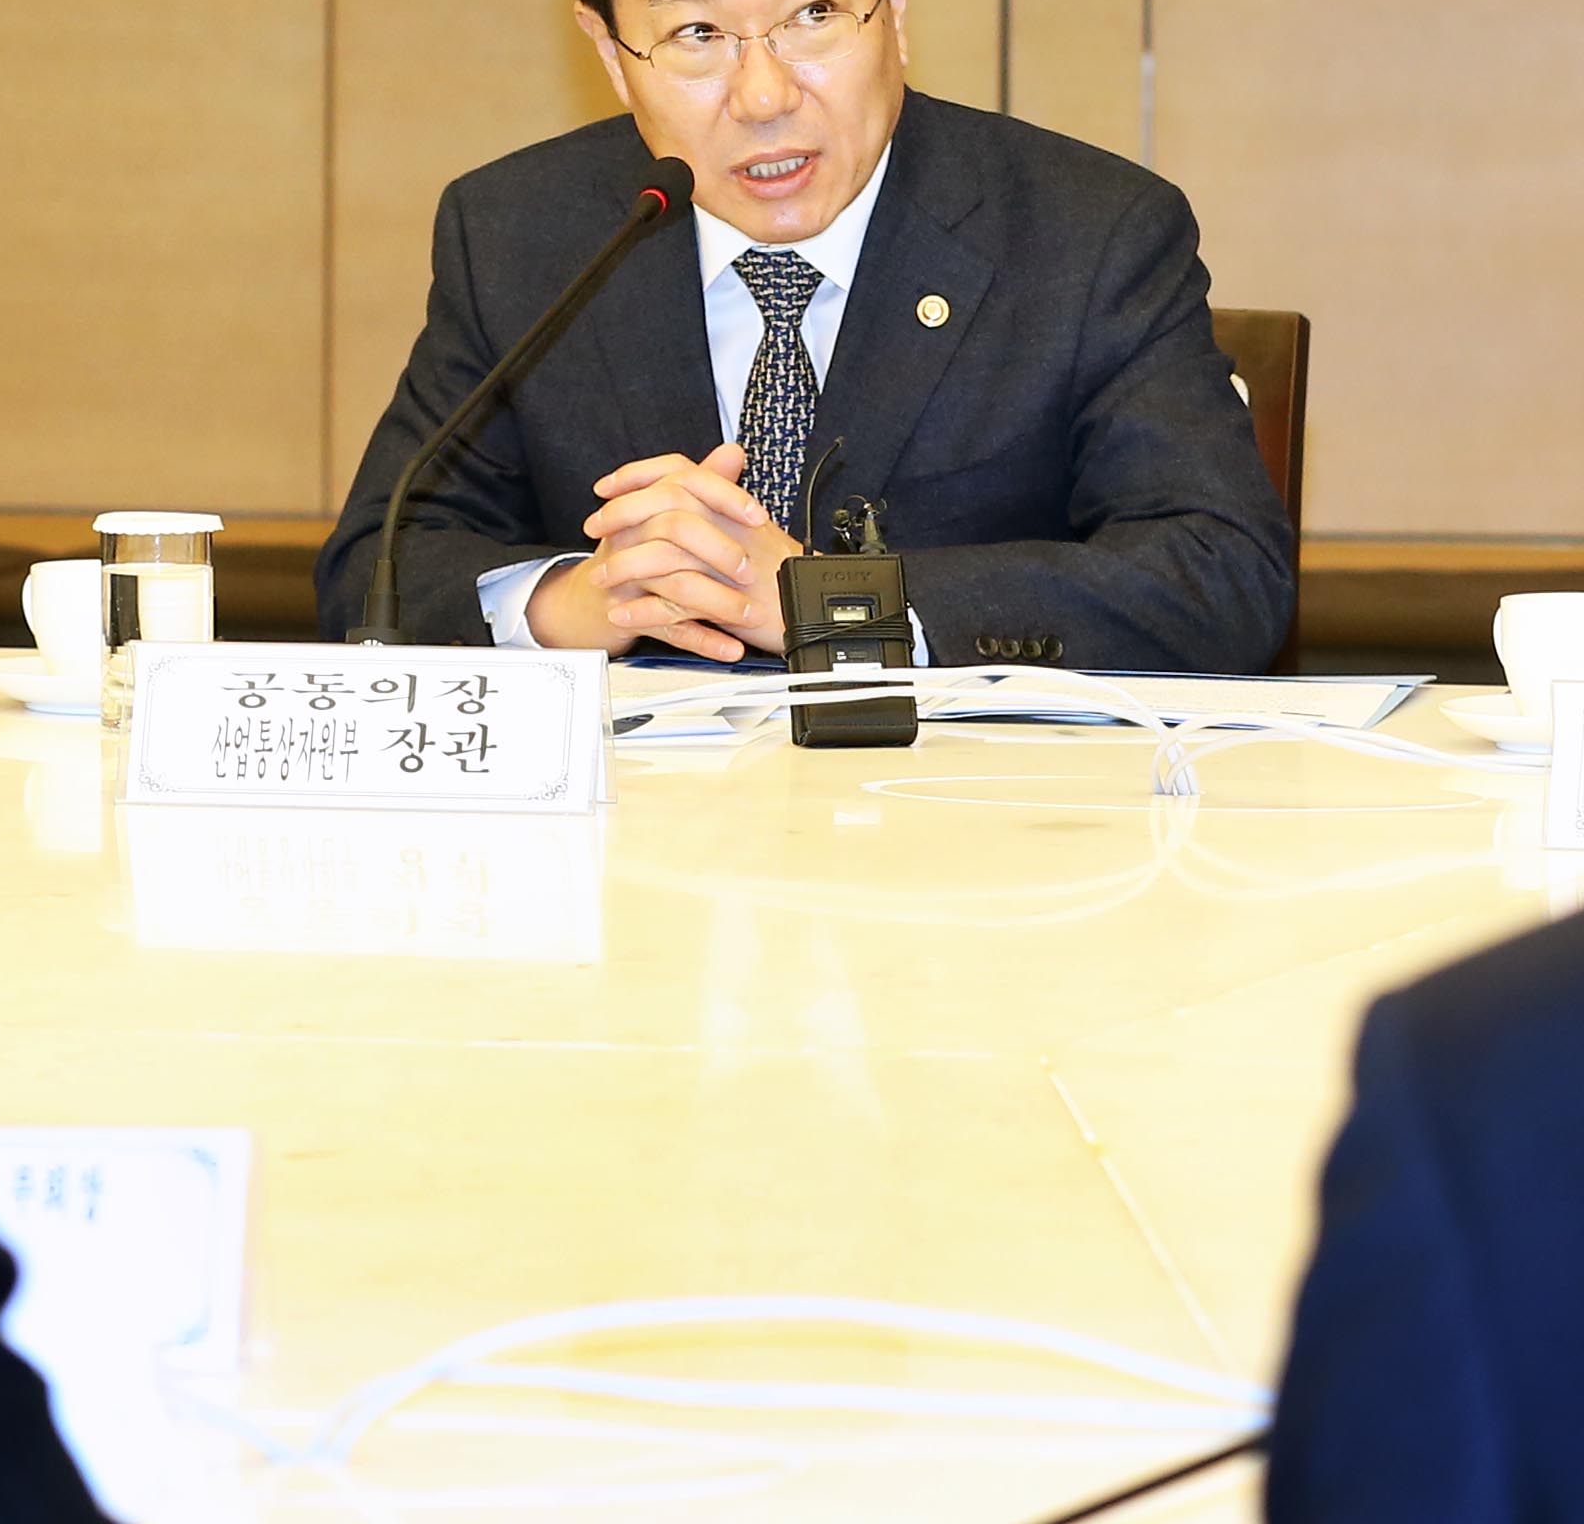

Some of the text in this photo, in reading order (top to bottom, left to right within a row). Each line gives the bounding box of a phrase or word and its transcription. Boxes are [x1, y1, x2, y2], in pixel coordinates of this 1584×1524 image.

[221, 672, 499, 715] 공동의장
[212, 716, 499, 783] 산업통상자원부 장관
